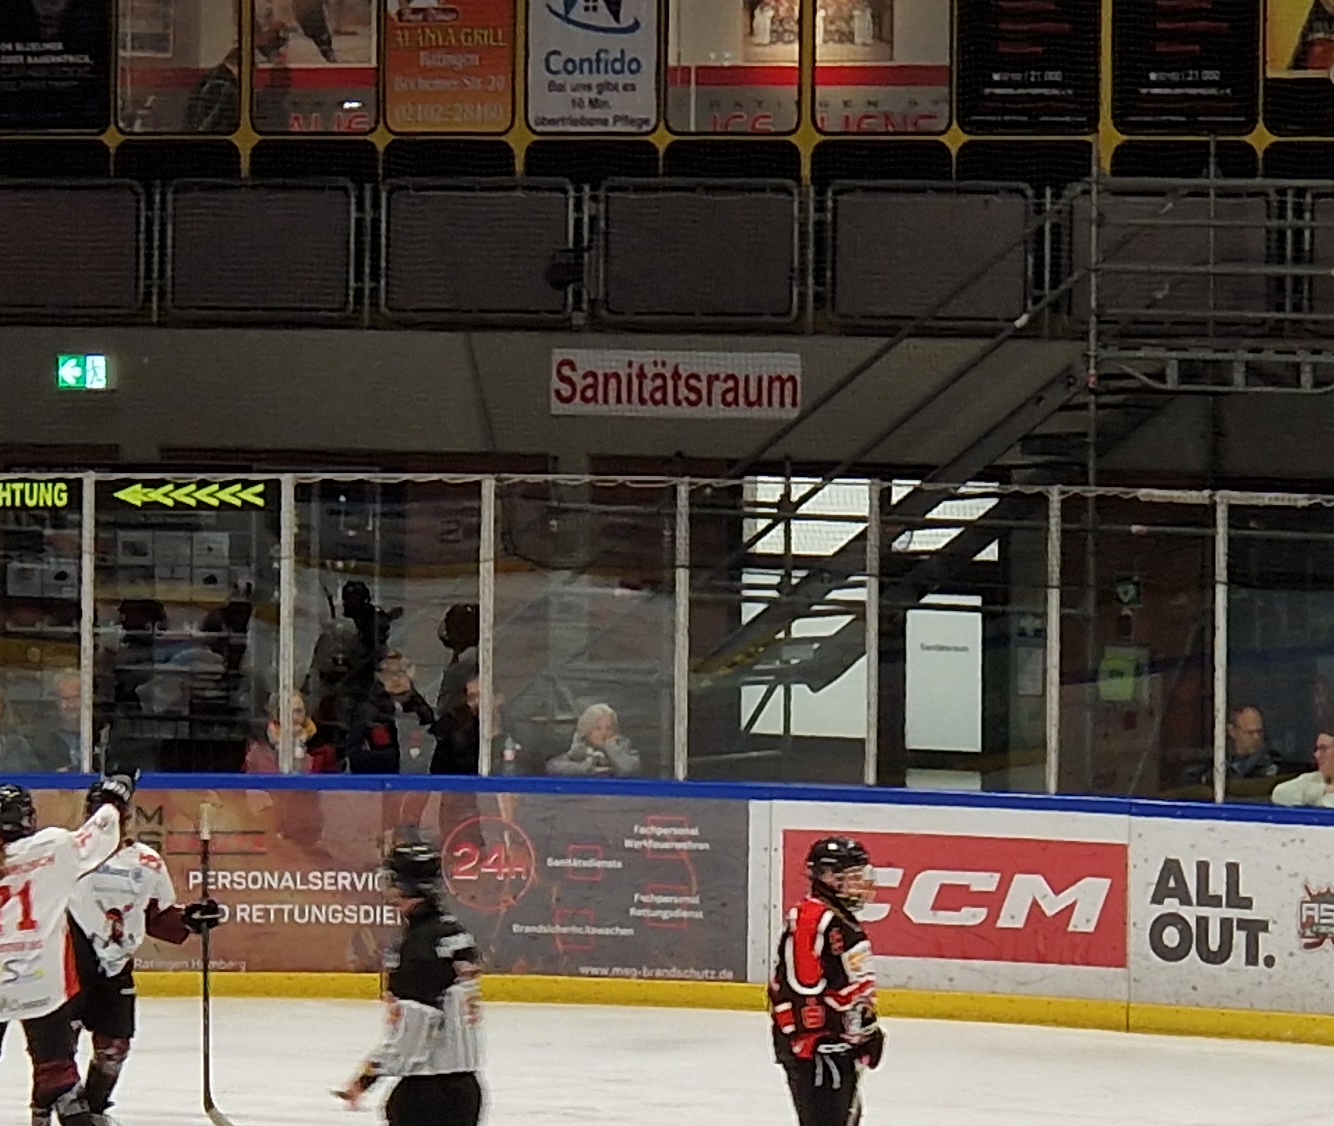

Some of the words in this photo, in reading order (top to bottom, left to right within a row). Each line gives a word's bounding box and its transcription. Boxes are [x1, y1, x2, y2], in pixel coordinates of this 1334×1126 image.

[544, 48, 643, 75] Confido
[554, 358, 799, 409] Sanitätsraum
[1150, 857, 1254, 910] ALL
[1149, 912, 1276, 968] OUT.
